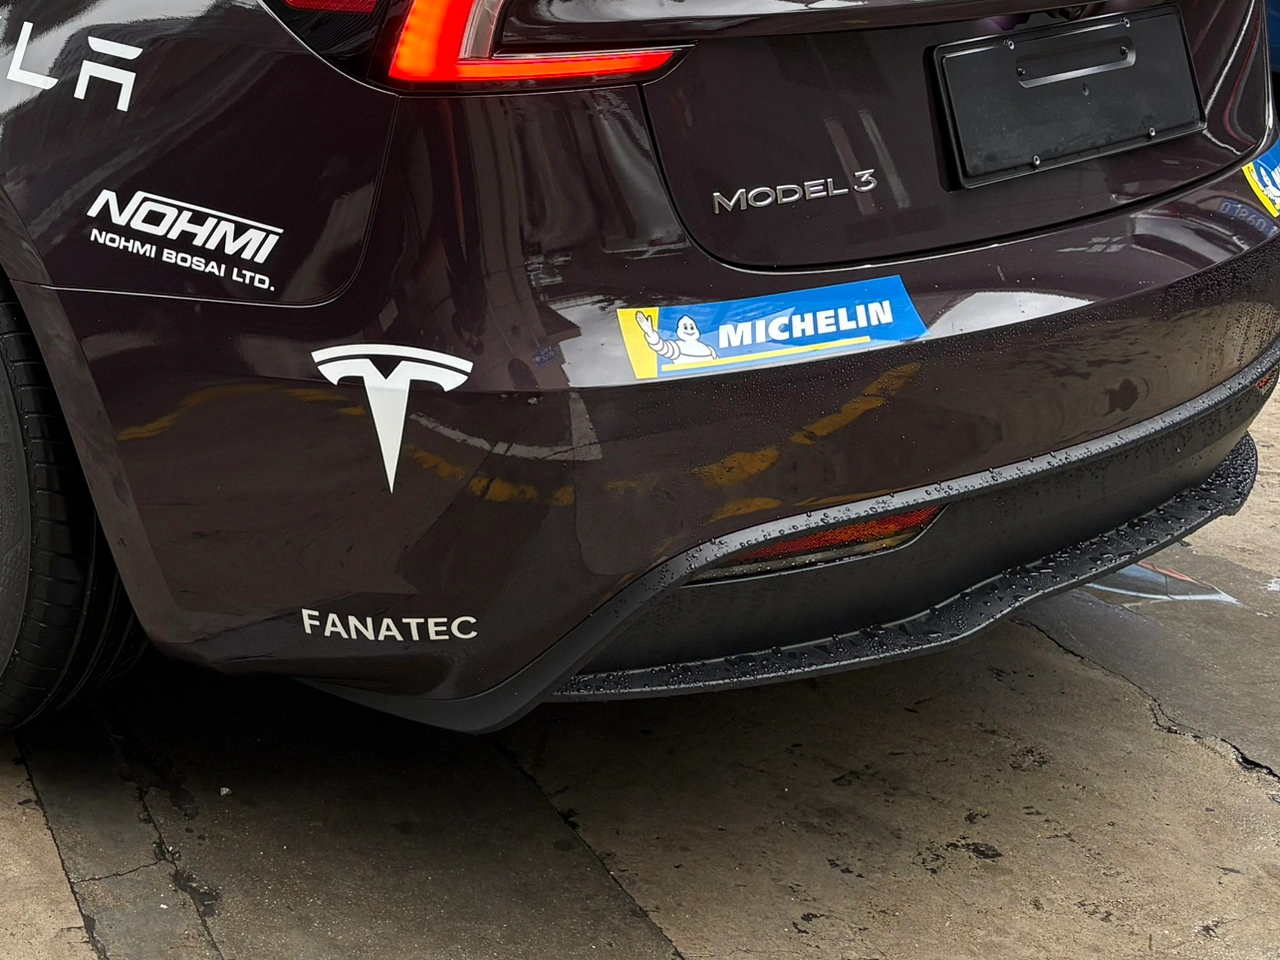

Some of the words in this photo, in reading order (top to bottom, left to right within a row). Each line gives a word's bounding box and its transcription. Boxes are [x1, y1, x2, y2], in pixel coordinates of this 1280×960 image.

[712, 178, 849, 214] MODEL
[853, 168, 878, 193] 3
[86, 189, 285, 264] NOHMI
[90, 228, 157, 258] NOHMI
[161, 248, 226, 278] BOSAI
[232, 267, 275, 292] LTD.
[719, 300, 894, 349] MICHELIN
[301, 608, 478, 642] FANATEC
